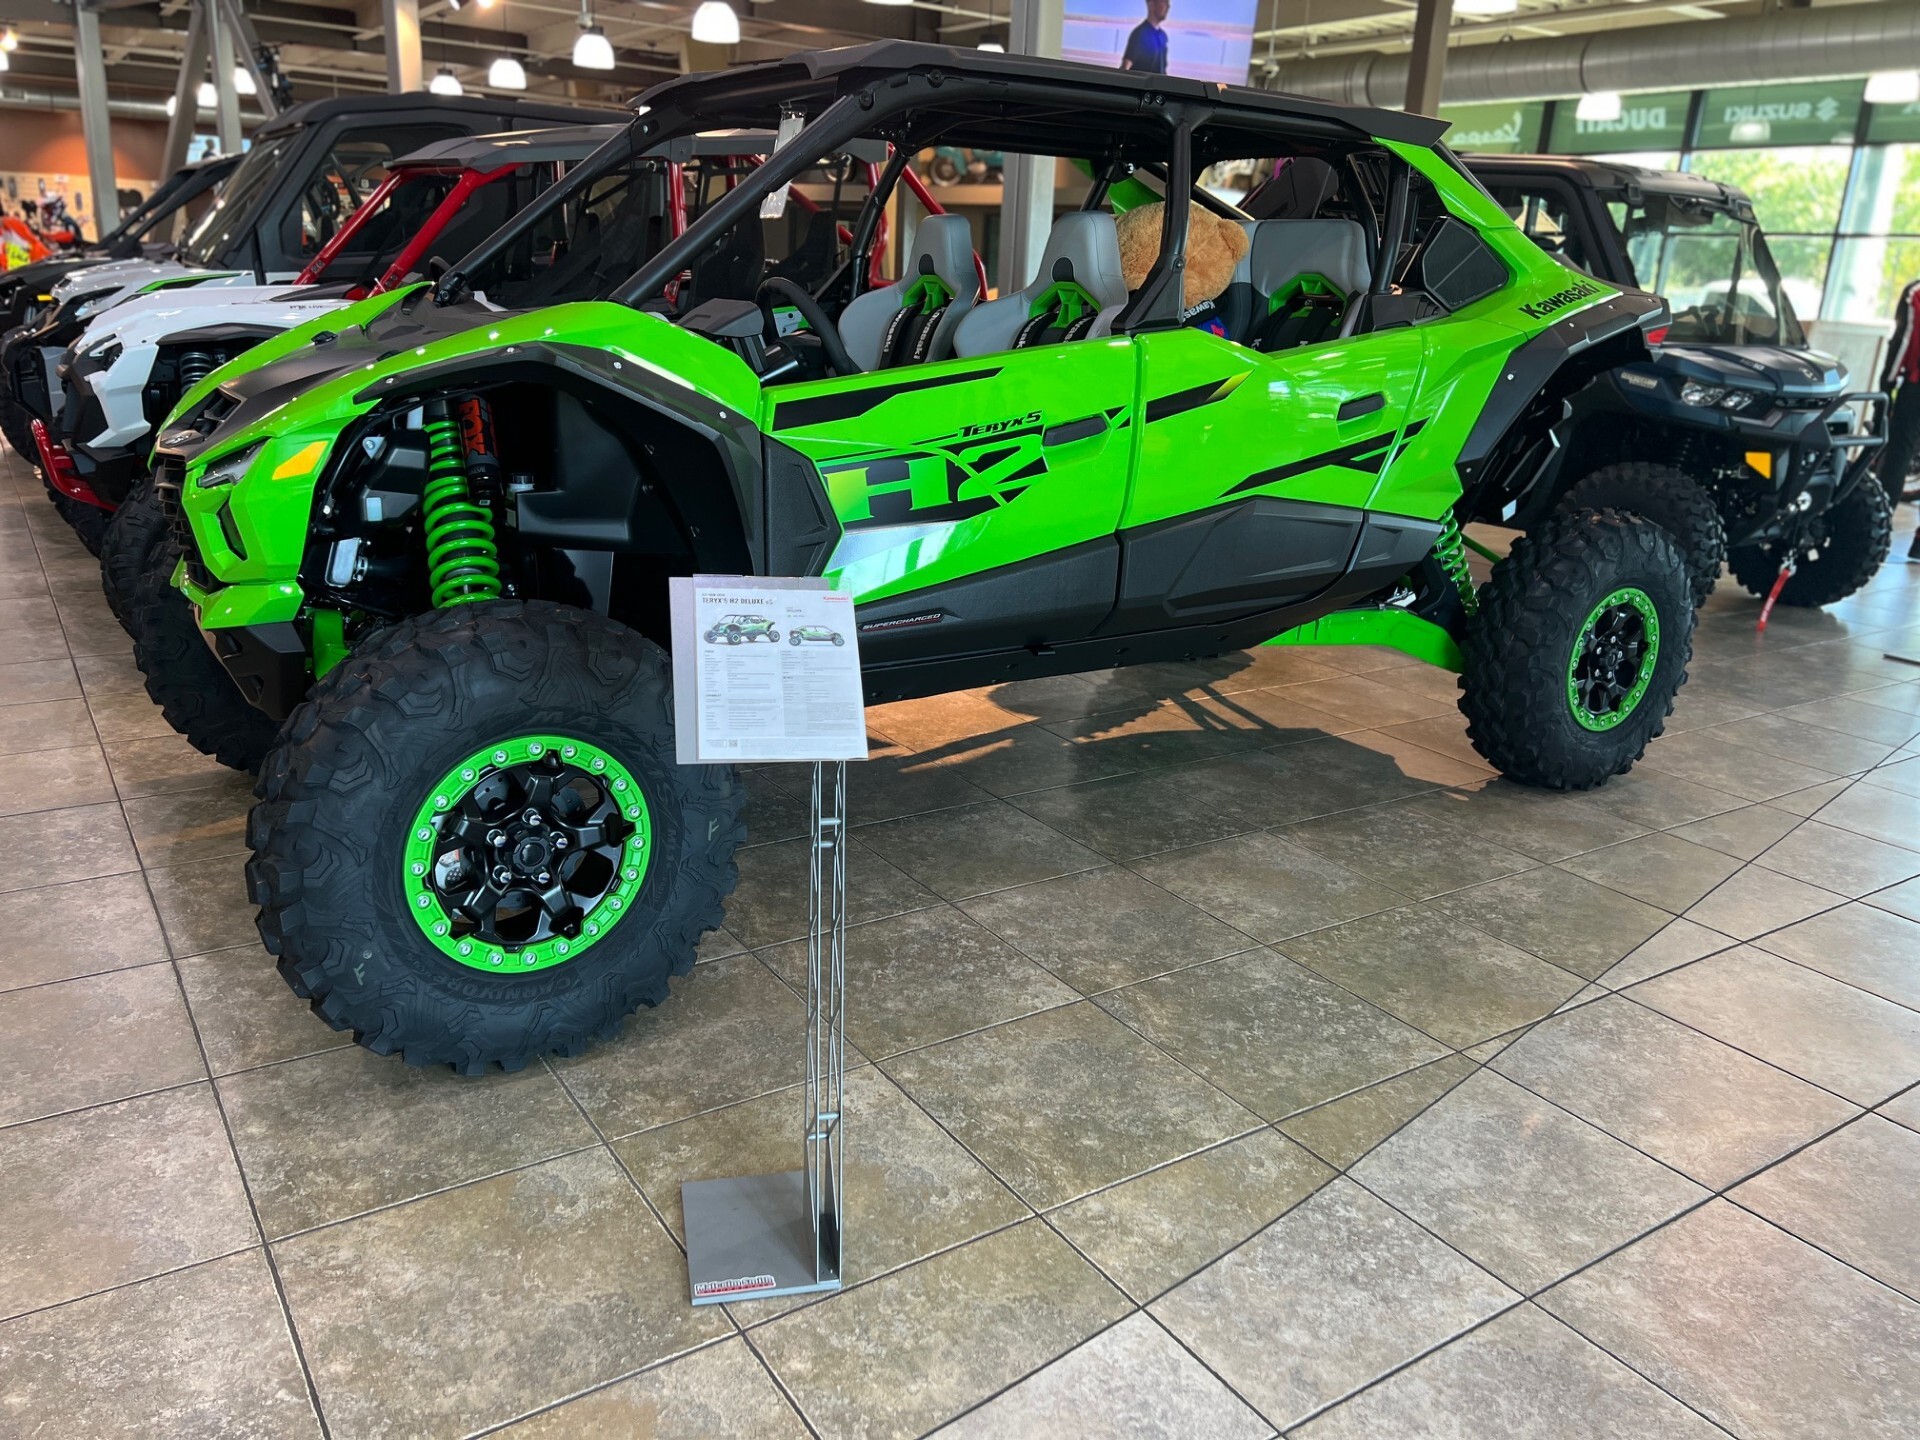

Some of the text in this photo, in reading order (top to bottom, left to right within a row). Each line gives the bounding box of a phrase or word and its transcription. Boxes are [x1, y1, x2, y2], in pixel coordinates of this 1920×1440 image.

[1518, 280, 1600, 320] Kawasaki
[458, 398, 487, 455] FOX
[823, 434, 1049, 523] H2
[863, 613, 941, 629] SUPERCHARGED
